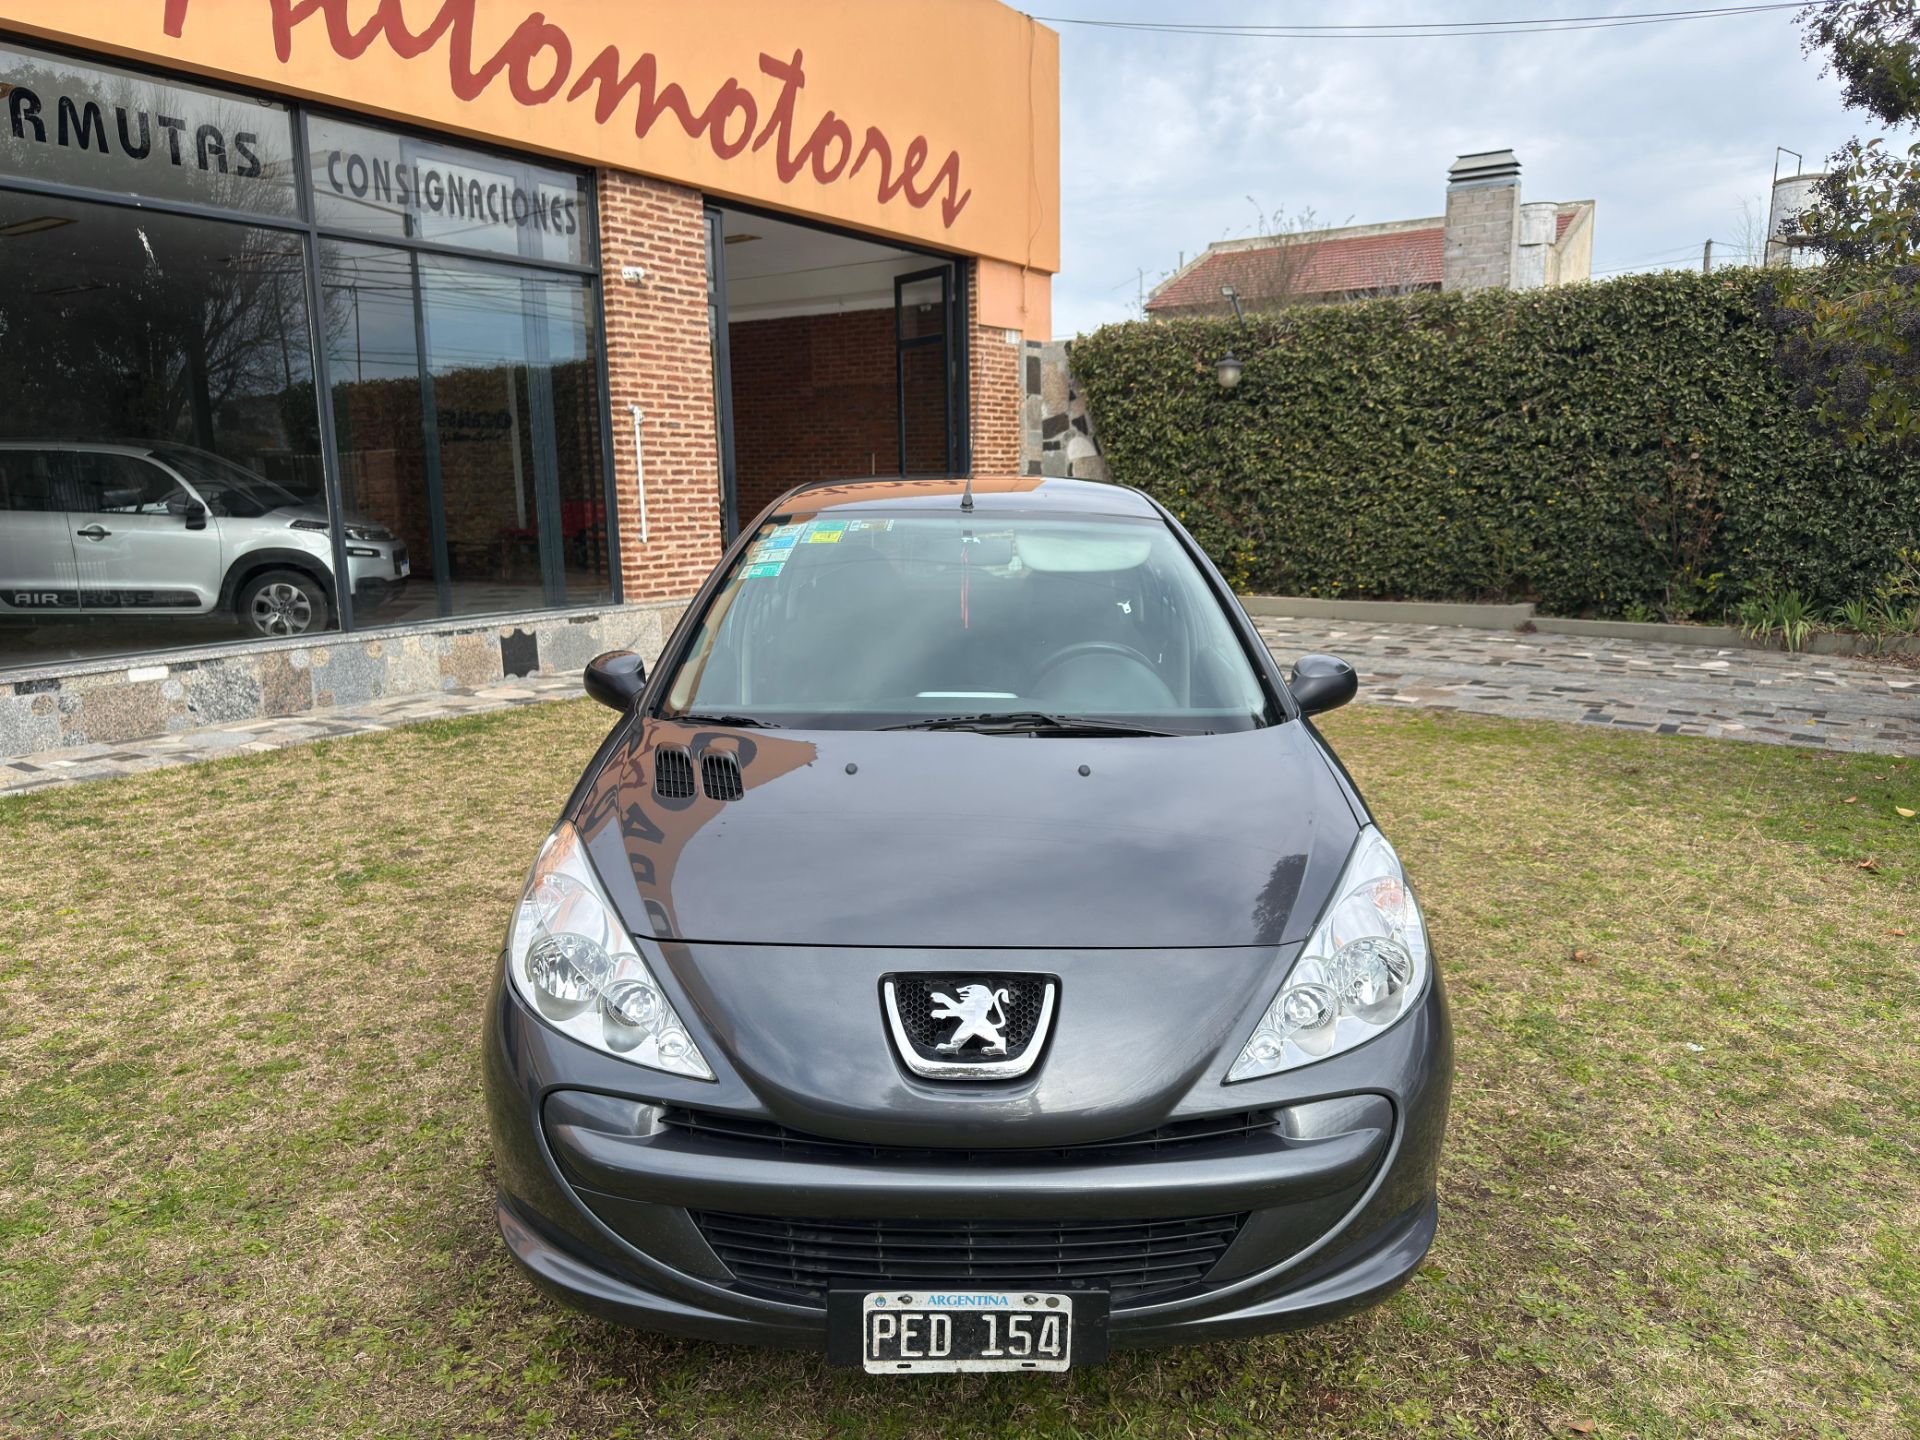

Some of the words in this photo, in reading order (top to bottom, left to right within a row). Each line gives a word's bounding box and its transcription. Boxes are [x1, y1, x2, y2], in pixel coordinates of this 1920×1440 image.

[9, 86, 262, 178] RMUTAS
[327, 150, 577, 236] CONSIGNACIONES
[927, 1294, 1009, 1307] ARGENTINA
[873, 1313, 952, 1357] PED
[981, 1314, 1061, 1357] 154
